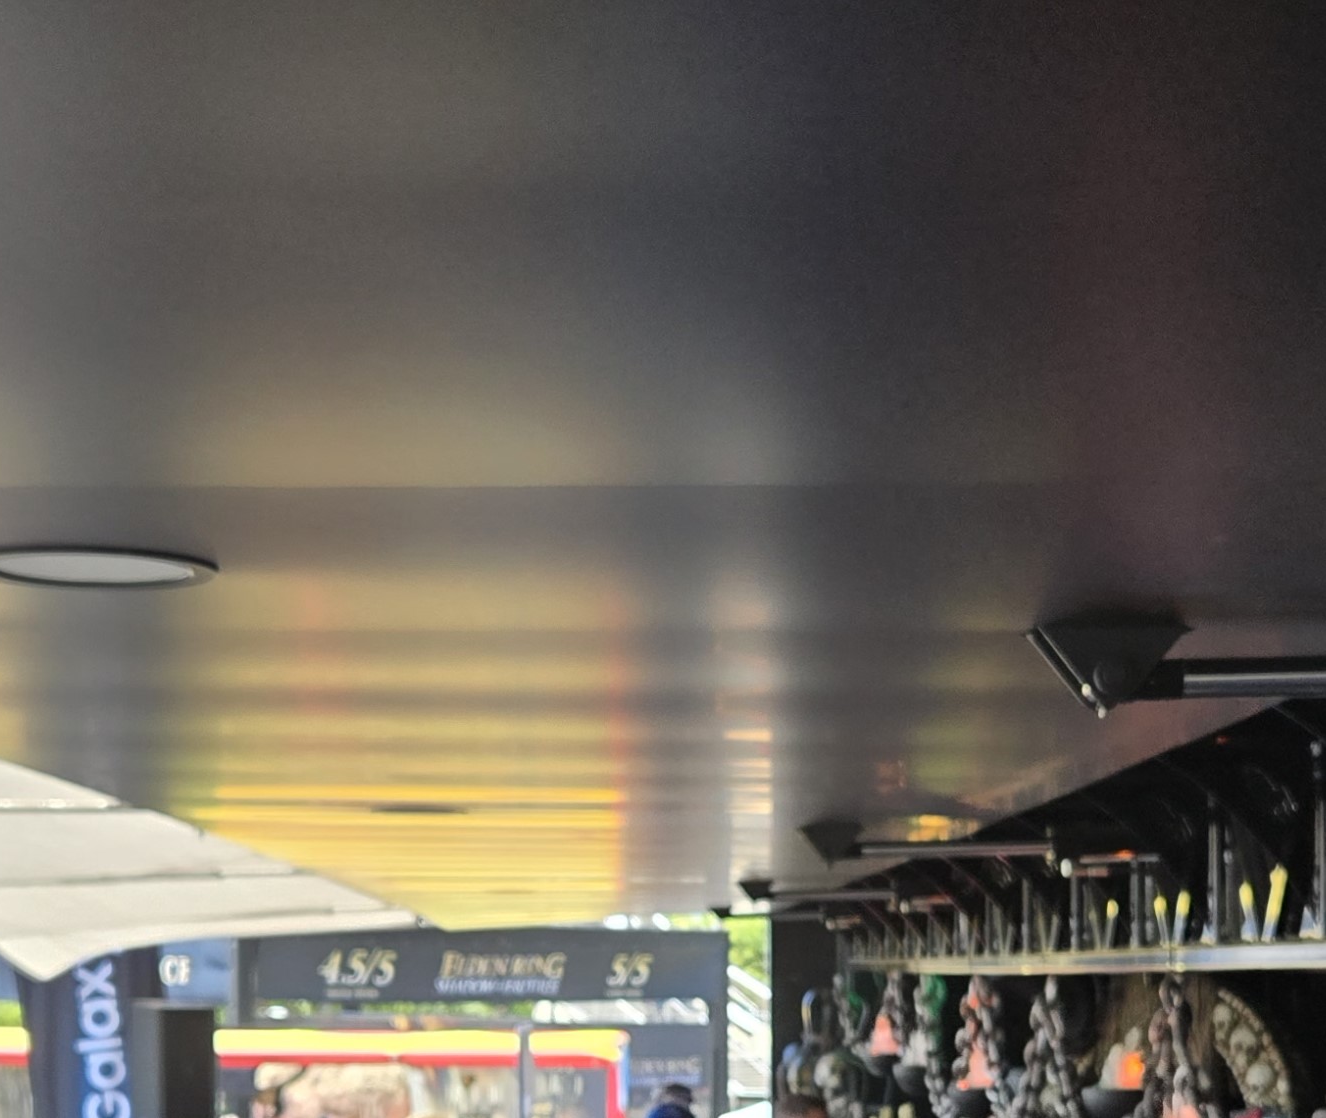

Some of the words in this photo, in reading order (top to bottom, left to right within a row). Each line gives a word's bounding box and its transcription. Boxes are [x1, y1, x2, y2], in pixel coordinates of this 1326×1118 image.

[317, 947, 397, 987] 4.5/5
[439, 950, 512, 980] ELDEN
[512, 951, 567, 980] RING
[606, 952, 655, 986] 5/5
